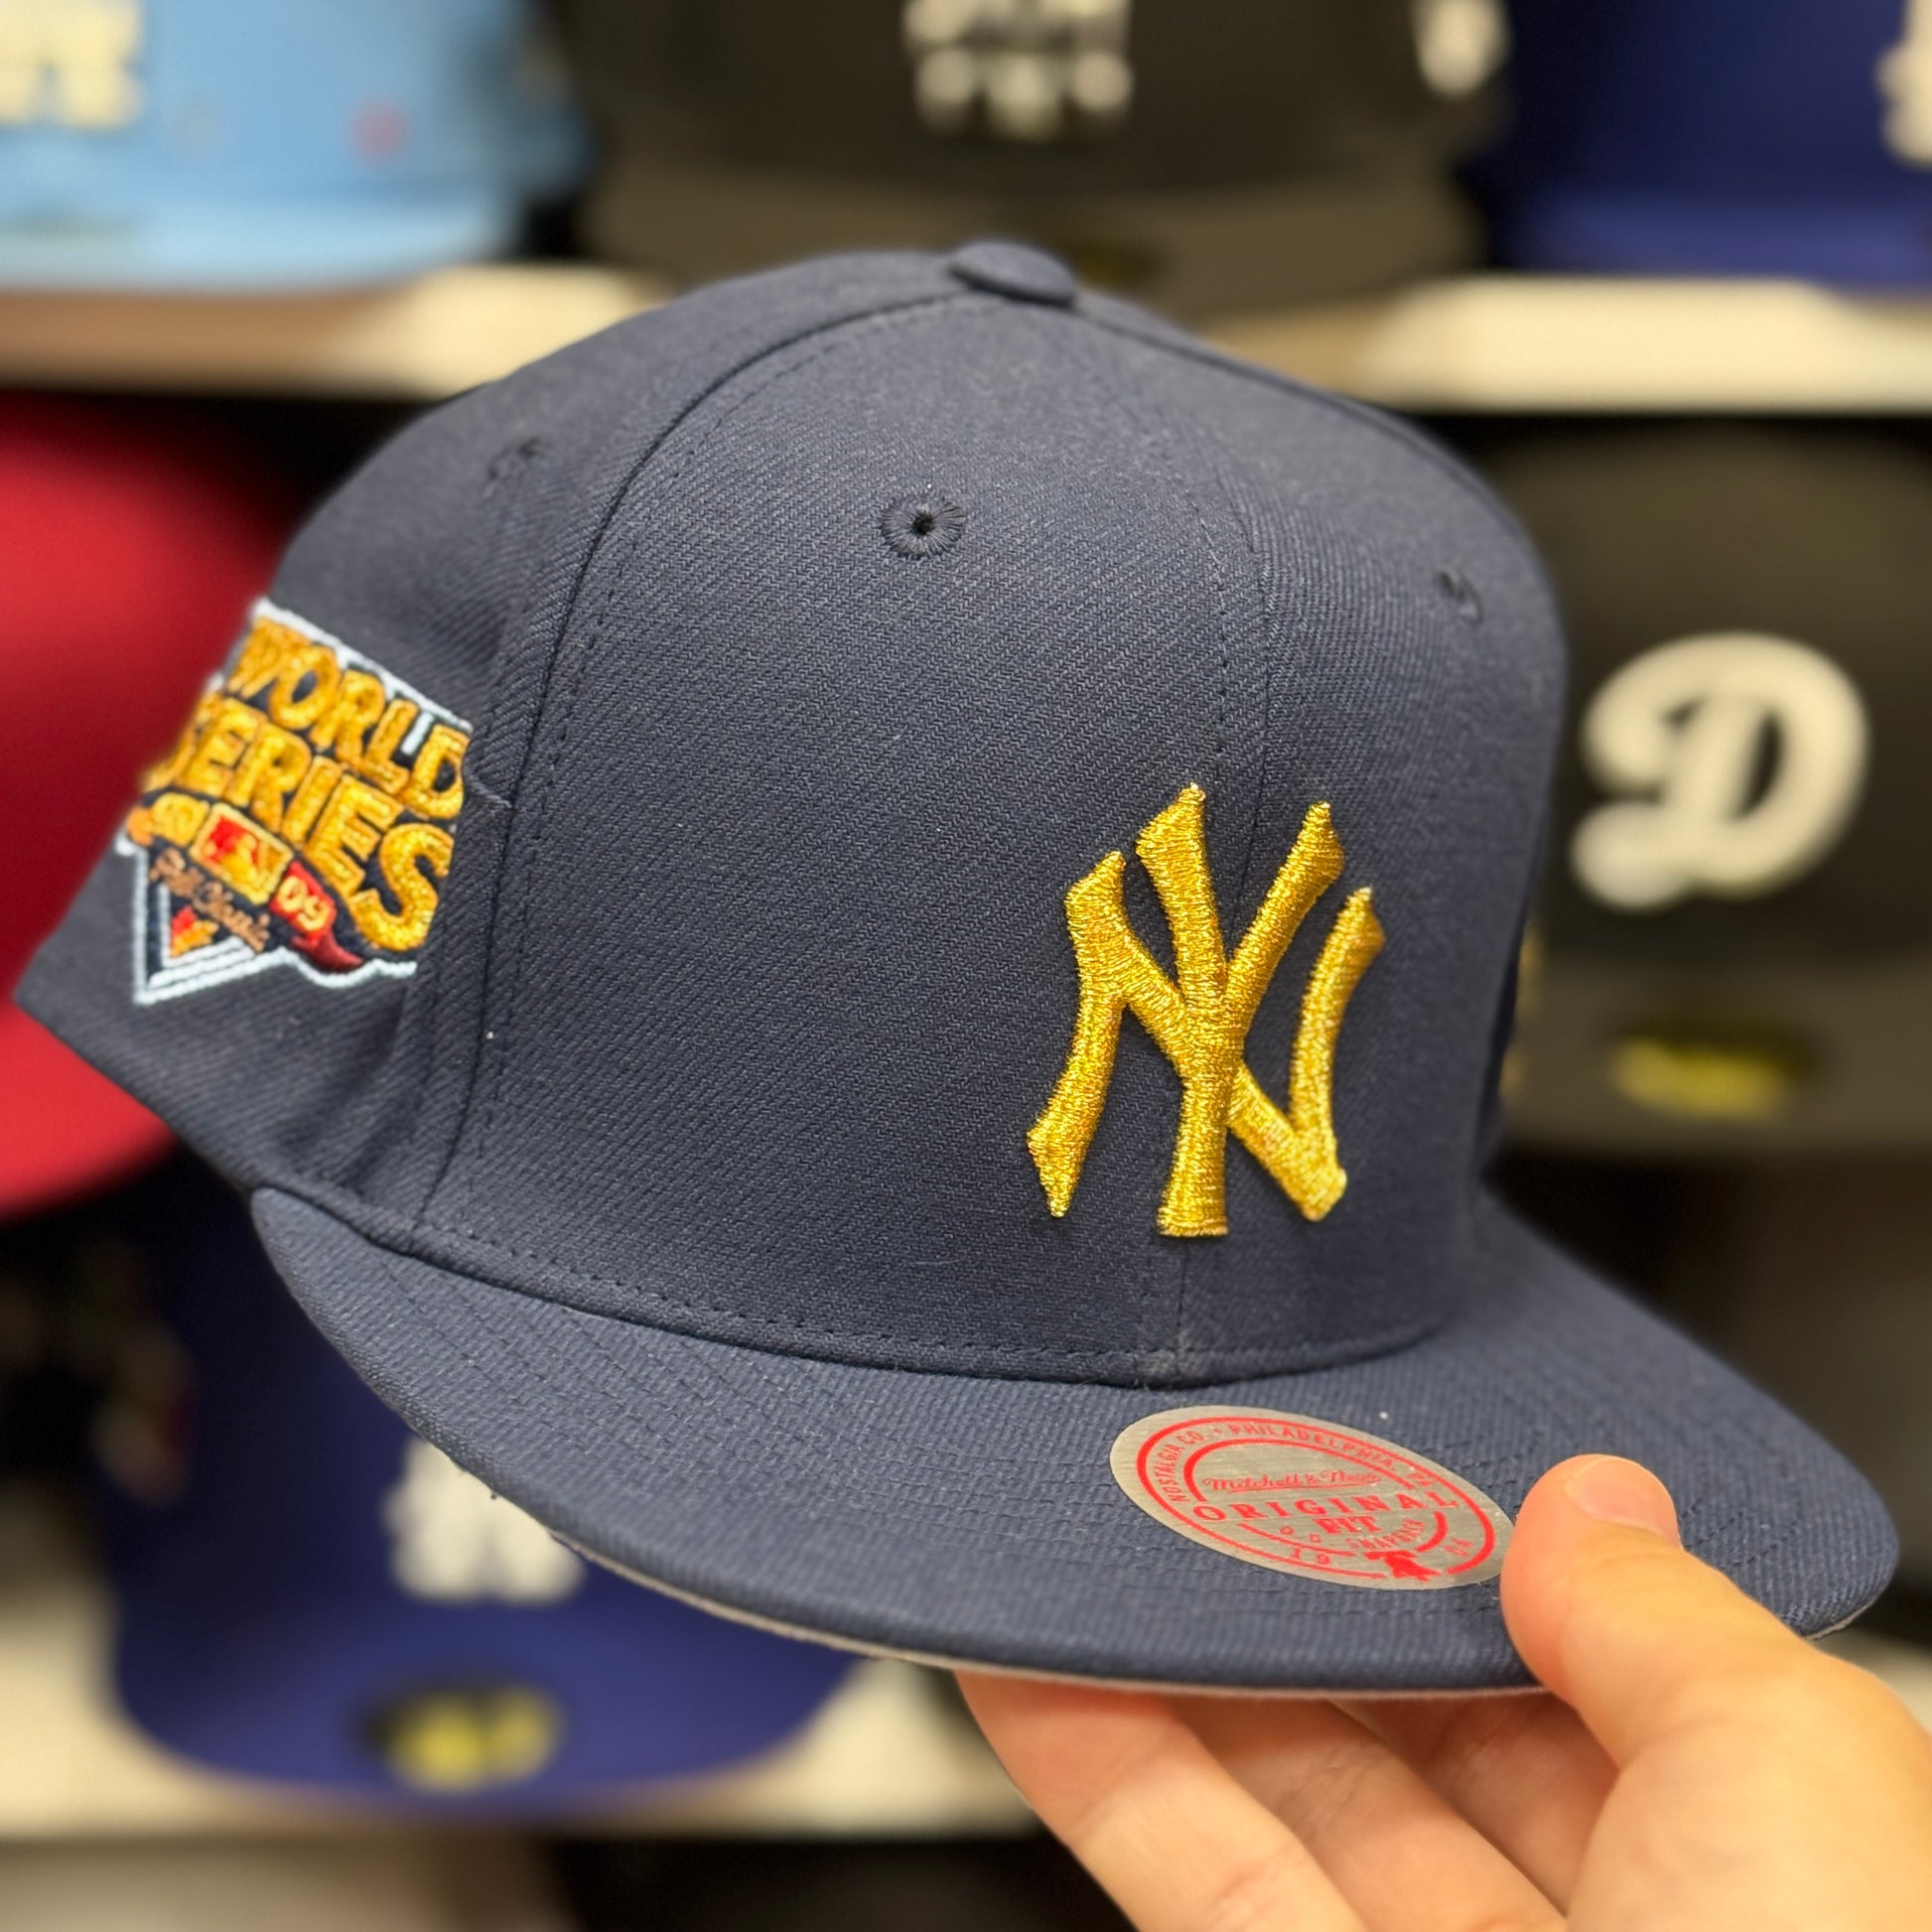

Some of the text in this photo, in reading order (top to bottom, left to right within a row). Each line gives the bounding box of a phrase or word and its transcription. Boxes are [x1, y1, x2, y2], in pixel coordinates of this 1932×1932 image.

[226, 617, 471, 819] WORLD
[1577, 631, 1867, 910] D
[142, 689, 455, 951] SERIES
[1027, 782, 1386, 1236] NY
[1154, 1444, 1190, 1501] NOSTALGIA
[1193, 1489, 1457, 1521] ORIGINAL
[1202, 1468, 1381, 1492] Mitchell & Ness
[1312, 1515, 1381, 1535] FIT
